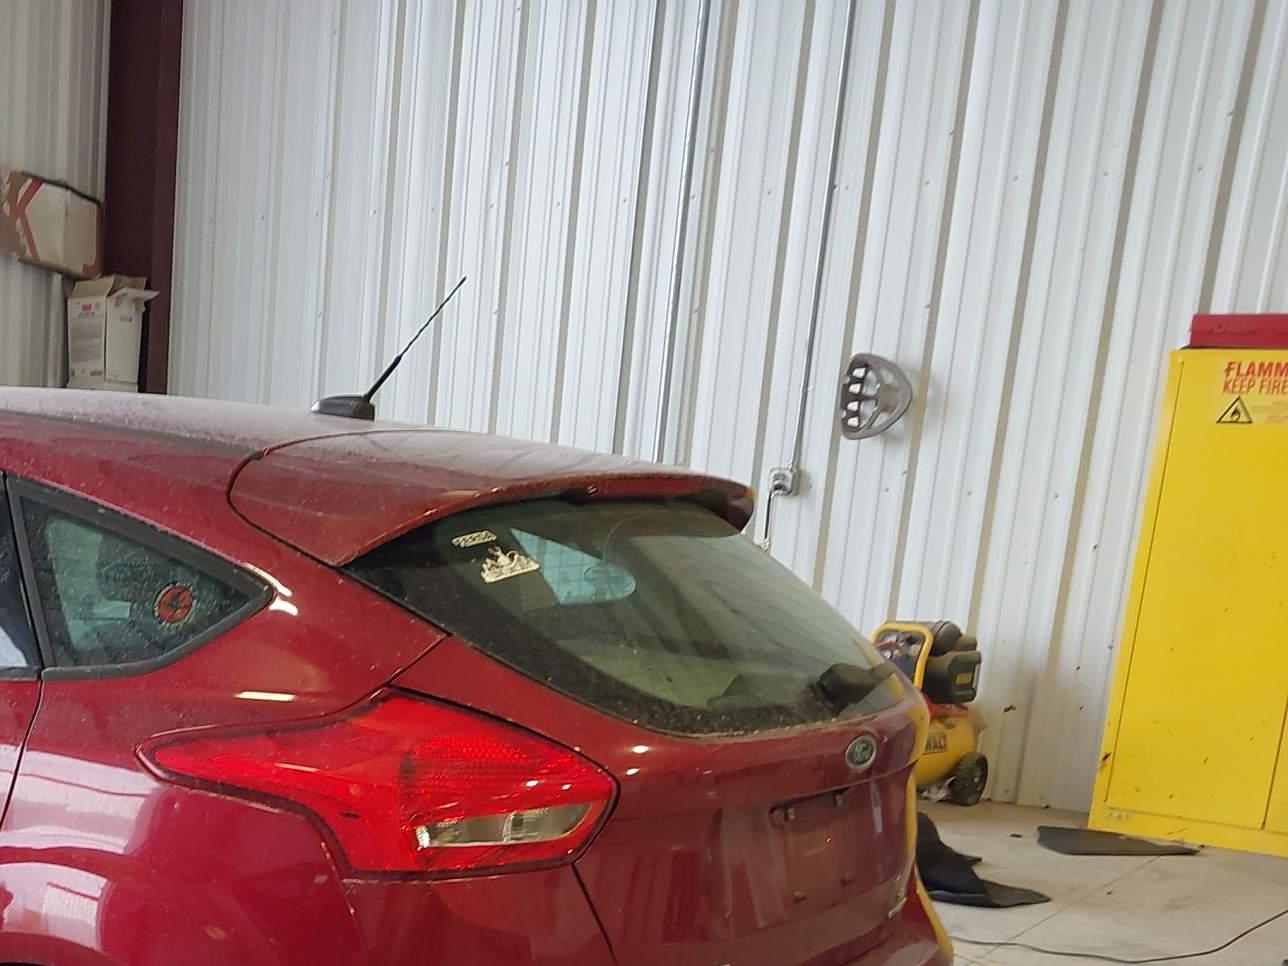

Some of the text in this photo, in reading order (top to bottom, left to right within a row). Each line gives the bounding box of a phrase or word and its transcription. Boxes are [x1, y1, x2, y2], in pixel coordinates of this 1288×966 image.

[1223, 361, 1288, 377] FLAMM
[1223, 378, 1288, 395] KEEP FIRE
